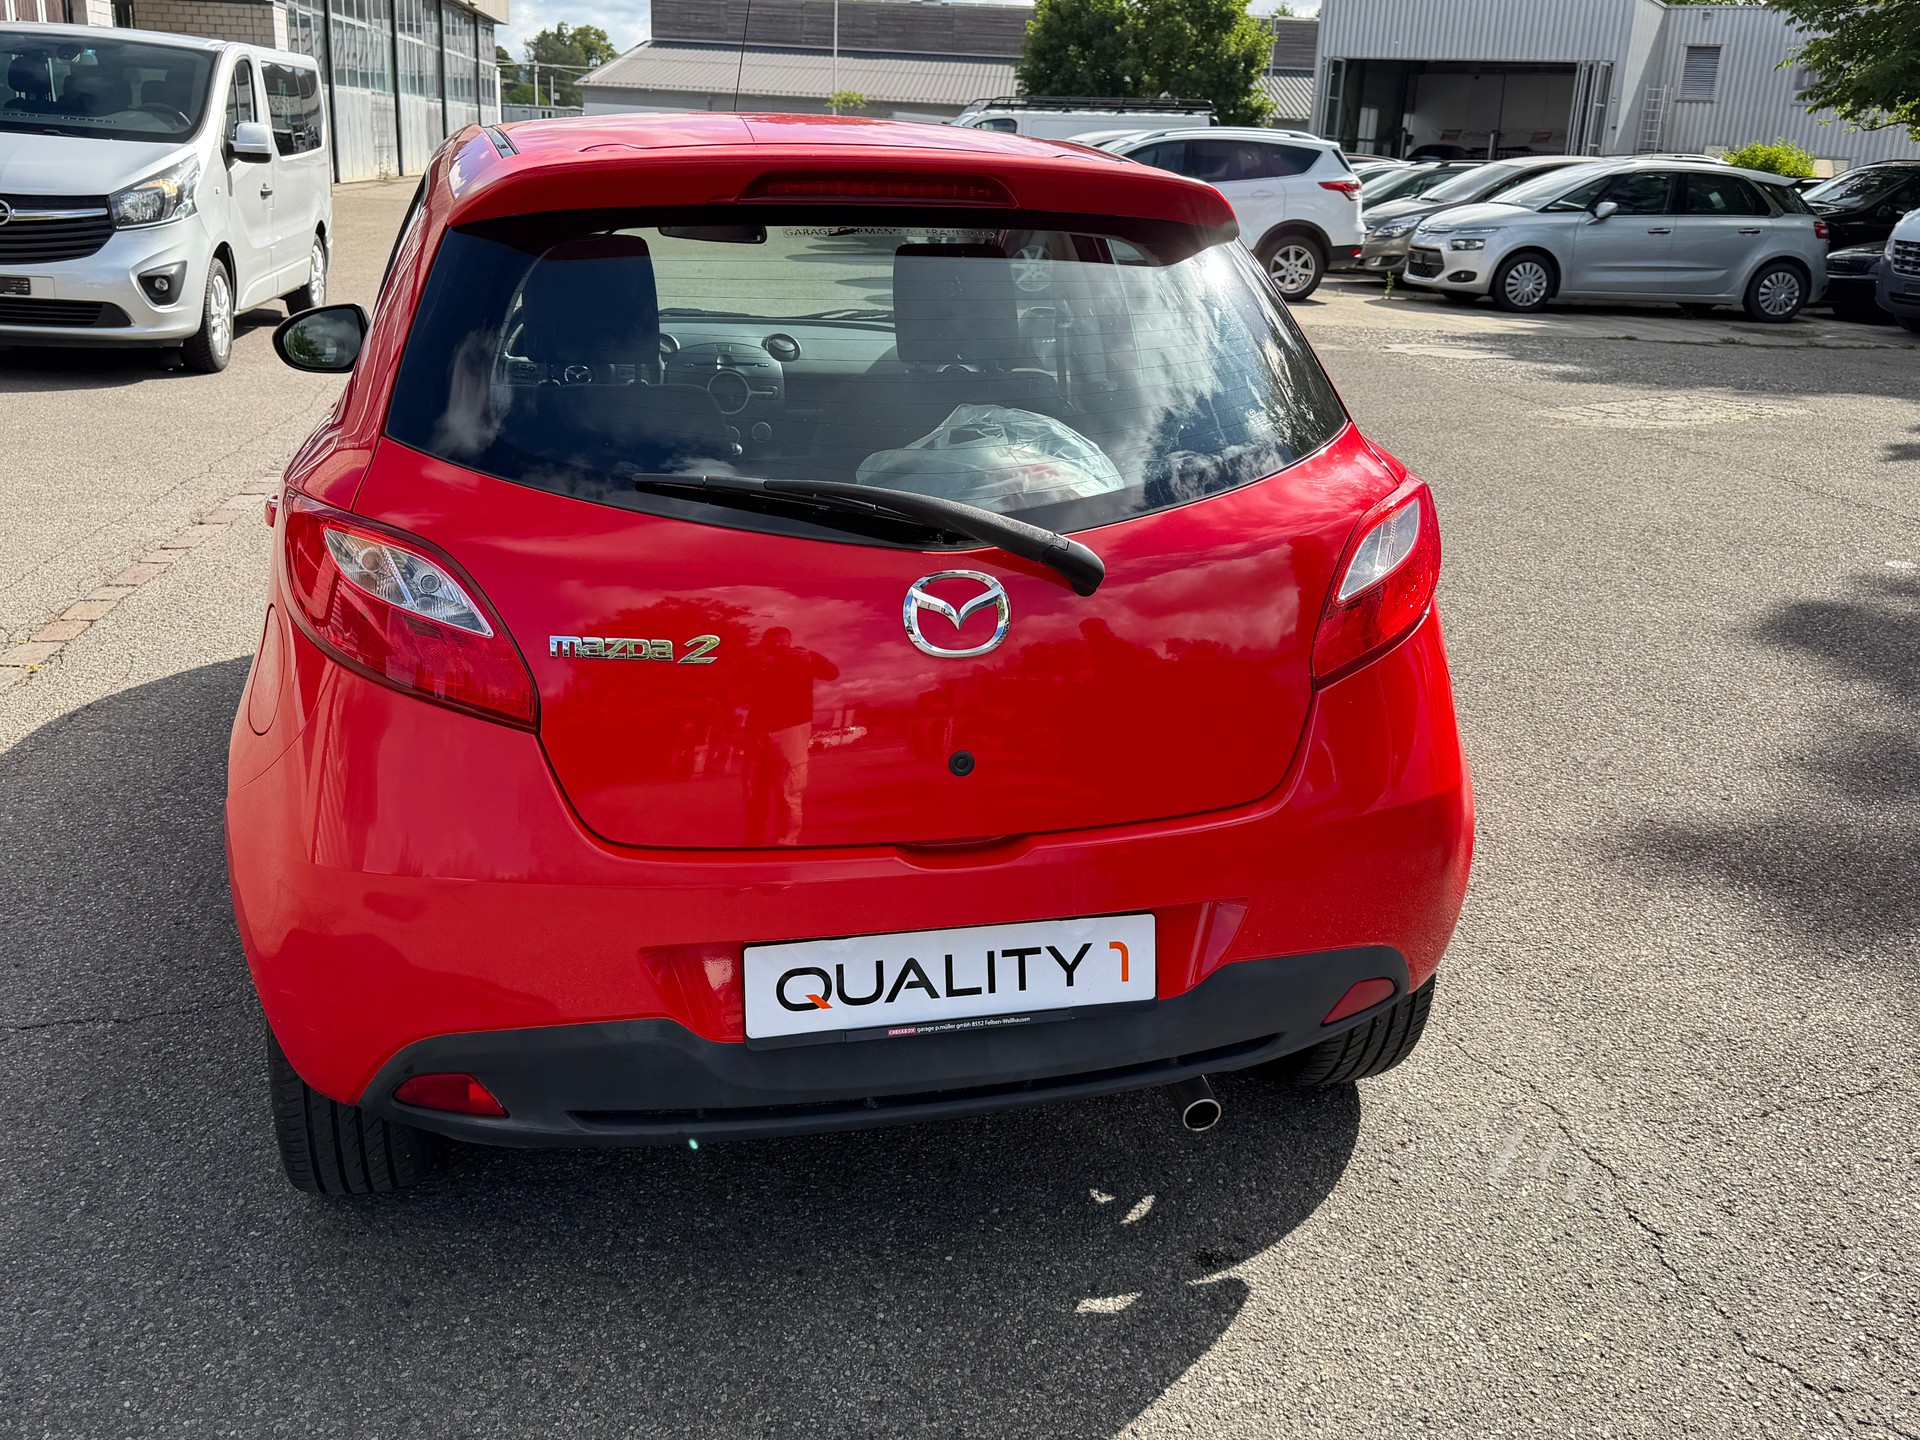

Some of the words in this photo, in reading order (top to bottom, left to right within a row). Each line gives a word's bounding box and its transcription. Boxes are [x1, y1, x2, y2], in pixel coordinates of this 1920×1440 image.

[784, 227, 834, 237] GARAGE
[677, 634, 721, 664] 2
[775, 942, 1093, 1012] QUALITY
[1108, 941, 1130, 983] 1
